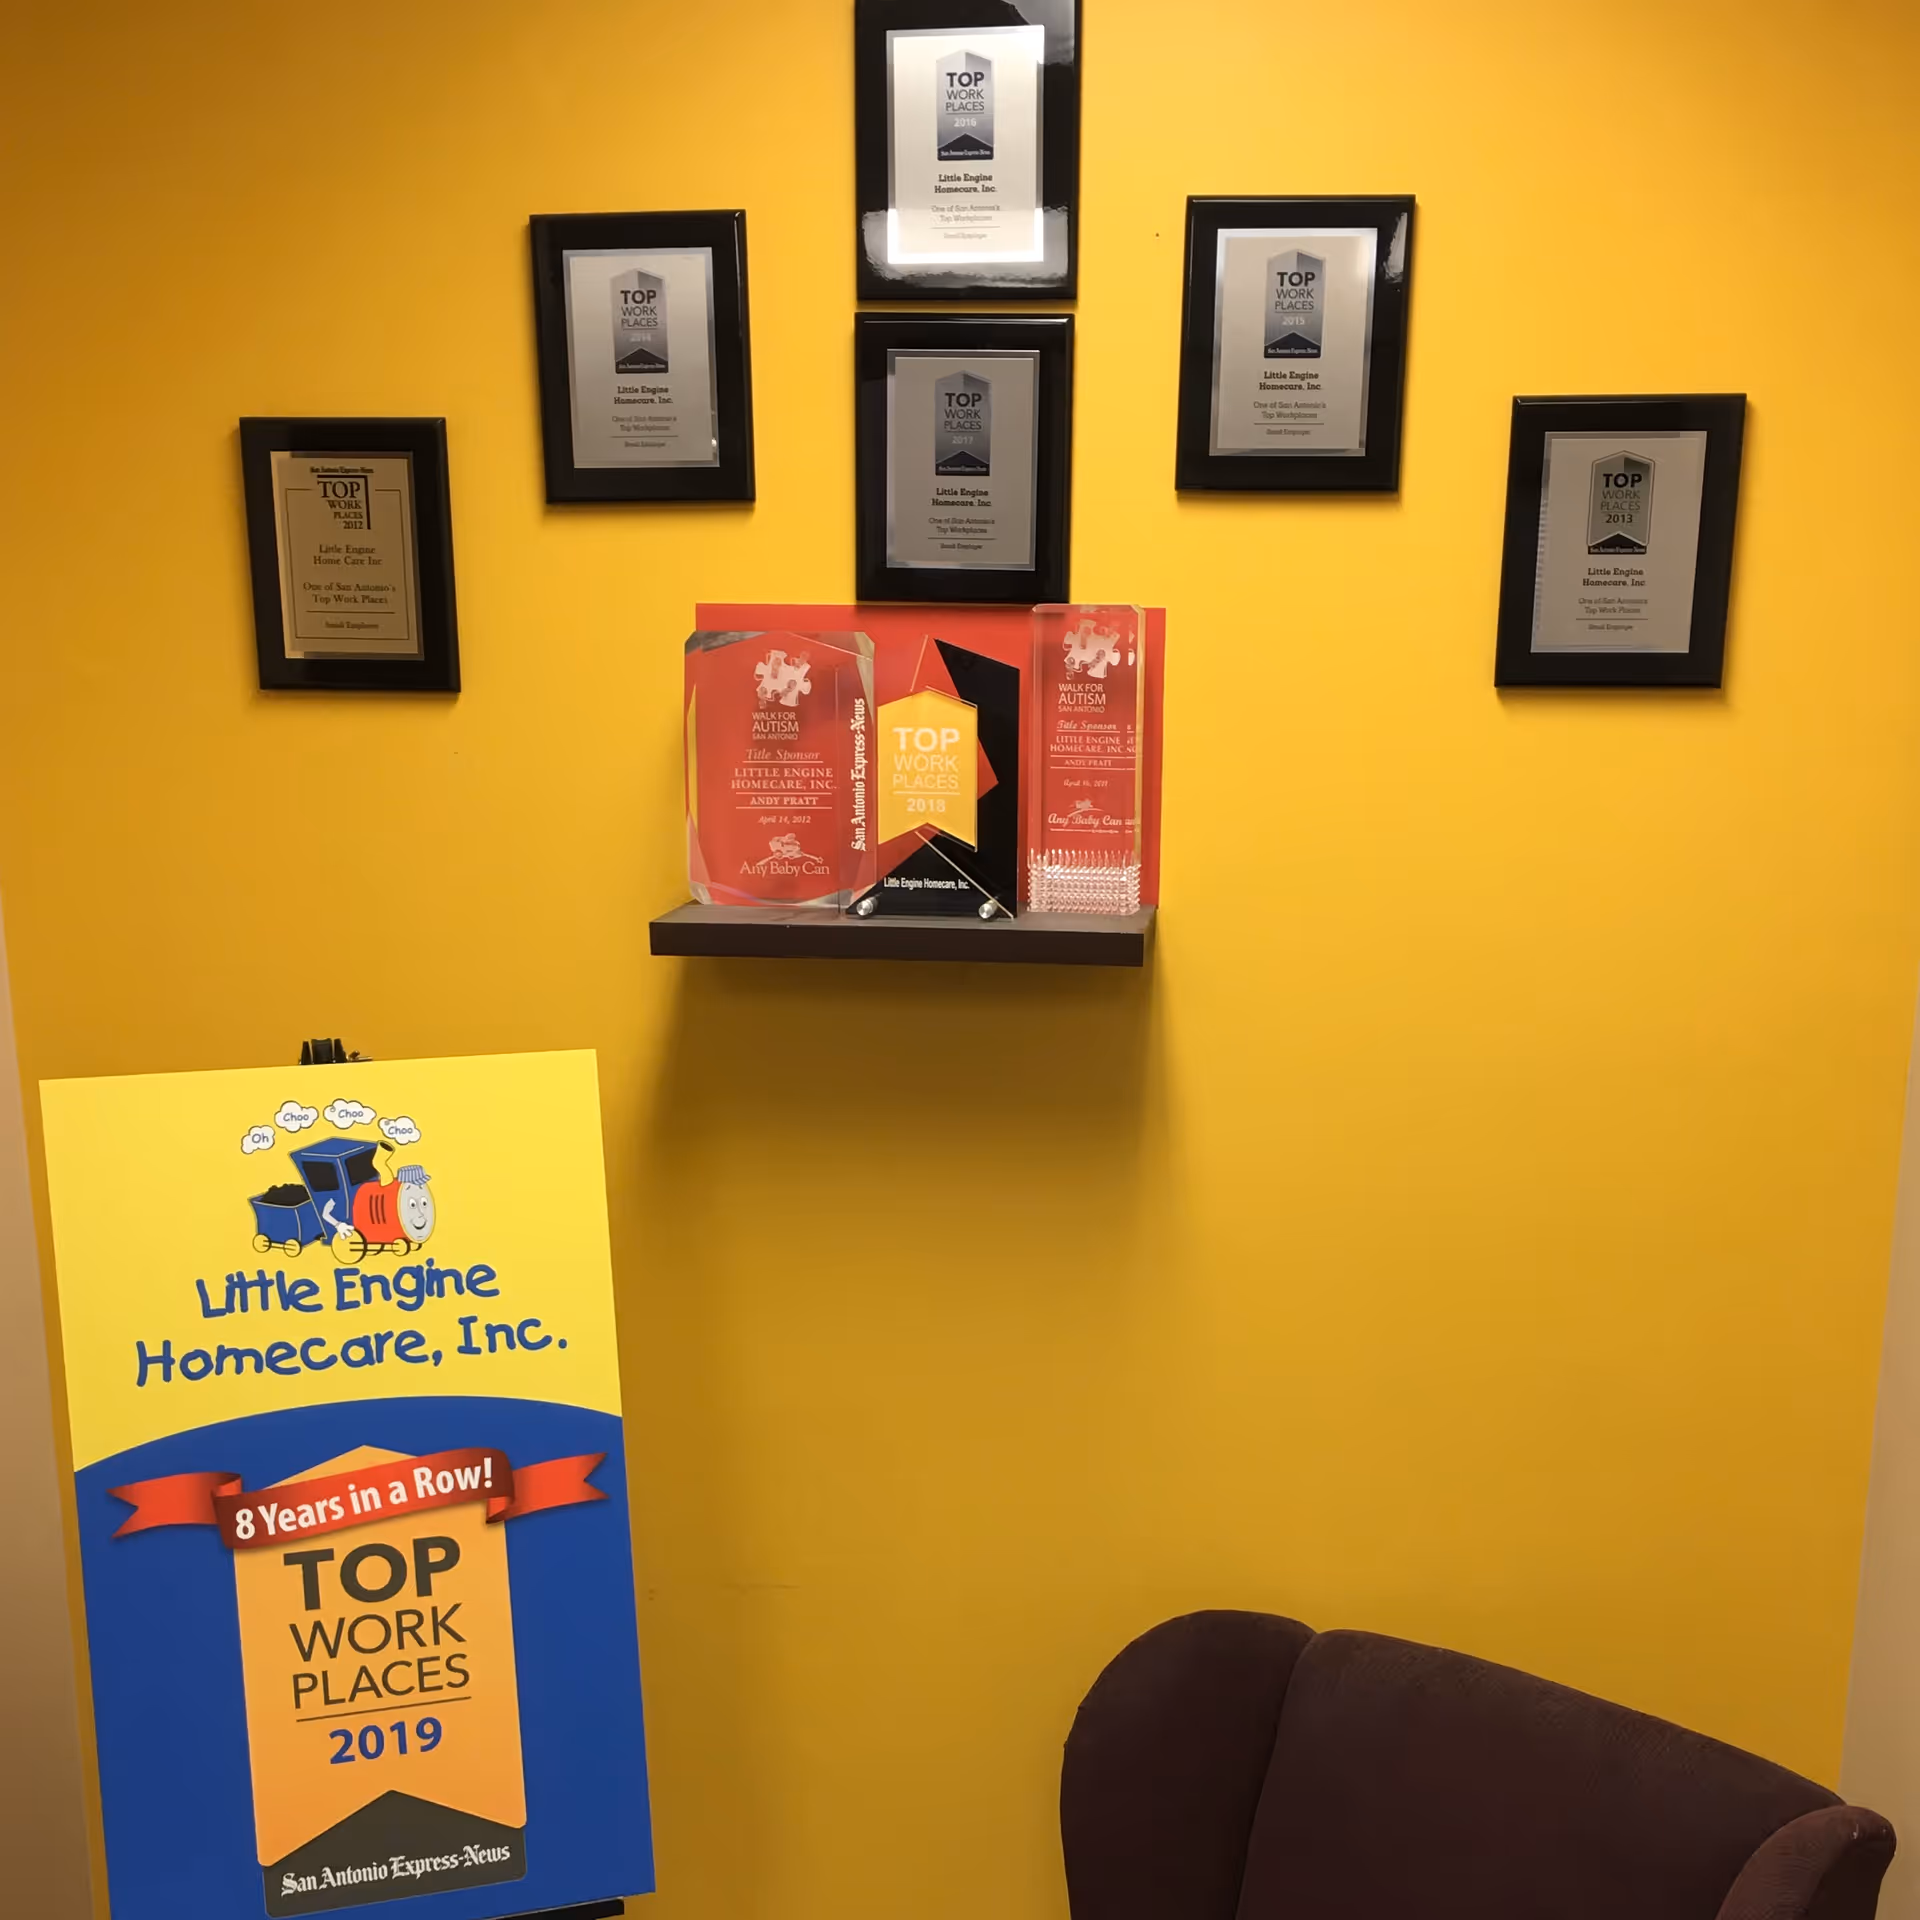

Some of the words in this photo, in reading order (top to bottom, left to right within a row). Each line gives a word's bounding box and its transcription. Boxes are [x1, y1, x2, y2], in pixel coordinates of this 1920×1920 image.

[945, 71, 985, 88] TOP
[946, 89, 984, 100] WORK
[945, 101, 985, 112] PLACES
[953, 117, 977, 127] 2016
[938, 173, 962, 182] Little
[963, 173, 993, 183] Engine
[1276, 271, 1316, 287] TOP
[620, 290, 657, 304] TOP
[1276, 288, 1314, 299] WORK
[621, 306, 657, 316] WORK
[1275, 301, 1314, 310] PLACES
[621, 318, 658, 327] PLACES
[1264, 371, 1287, 379] Little
[1288, 371, 1319, 381] Engine
[617, 386, 639, 394] Little
[641, 386, 669, 395] Engine
[945, 393, 982, 407] TOP
[944, 409, 982, 419] WORK
[944, 421, 982, 430] PLACES
[1603, 473, 1643, 488] TOP
[317, 481, 361, 499] TOP
[936, 488, 958, 496] Little
[960, 488, 988, 498] Engine
[1602, 490, 1640, 499] WORK
[327, 500, 362, 510] WORK
[1600, 501, 1641, 511] PLACES
[333, 511, 363, 520] PLACES
[1605, 514, 1633, 523] 2013
[342, 521, 363, 530] 2012
[319, 544, 342, 554] Little
[346, 544, 376, 555] Engine
[313, 555, 341, 565] Home
[344, 555, 365, 566] Care
[1588, 567, 1611, 575] Little
[1613, 567, 1643, 577] Engine
[303, 582, 322, 591] One
[324, 582, 334, 591] of
[336, 583, 352, 592] San
[312, 594, 331, 605] Top
[333, 594, 359, 604] Work
[361, 595, 388, 604] Places
[1058, 683, 1084, 693] WALK
[1085, 683, 1104, 693] FOR
[1058, 693, 1106, 705] AUTISM
[1058, 705, 1072, 713] SAN
[752, 712, 777, 721] WALK
[778, 712, 796, 721] FOR
[752, 721, 800, 733] AUTISM
[851, 698, 868, 781] Express-News
[892, 727, 961, 751] TOP
[1056, 735, 1084, 744] LITTLE
[1086, 736, 1121, 745] ENGINE
[746, 749, 771, 761] Title
[776, 749, 820, 761] Sponsor
[894, 754, 959, 772] WORK
[734, 768, 780, 778] LITTLE
[784, 768, 833, 778] ENGINE
[731, 780, 807, 790] HOMECARE,
[810, 779, 837, 789] INC.
[892, 773, 959, 789] PLACES
[750, 797, 781, 805] ANDY
[783, 797, 819, 805] PRATT
[851, 782, 866, 826] Antonio
[907, 798, 946, 813] 2018
[758, 815, 776, 824] April
[778, 815, 790, 824] 14,
[792, 815, 811, 823] 2012
[1048, 813, 1069, 828] Any
[1071, 815, 1100, 829] Baby
[1102, 815, 1122, 826] Can
[851, 828, 866, 851] San
[740, 861, 767, 877] Any
[770, 861, 800, 877] Baby
[802, 862, 830, 875] Can
[884, 877, 900, 888] Little
[901, 877, 923, 890] Engine
[924, 878, 957, 890] Homecare,
[958, 879, 970, 889] Inc.
[283, 1112, 309, 1122] Choo
[338, 1109, 364, 1119] Choo
[387, 1126, 414, 1135] Choo
[251, 1133, 269, 1144] Oh
[195, 1269, 324, 1318] Little
[332, 1257, 500, 1312] Engine
[135, 1330, 443, 1387] Homecare,
[457, 1315, 568, 1355] Inc.
[235, 1509, 256, 1541] 8
[257, 1492, 344, 1536] Years
[347, 1483, 382, 1516] in
[387, 1480, 410, 1505] a
[412, 1456, 494, 1499] Row!
[283, 1536, 461, 1611] TOP
[289, 1602, 466, 1662] WORK
[292, 1653, 471, 1709] PLACES
[328, 1716, 443, 1764] 2019
[281, 1872, 317, 1897] San
[318, 1861, 388, 1890] Antonio
[389, 1843, 511, 1879] Express-News
